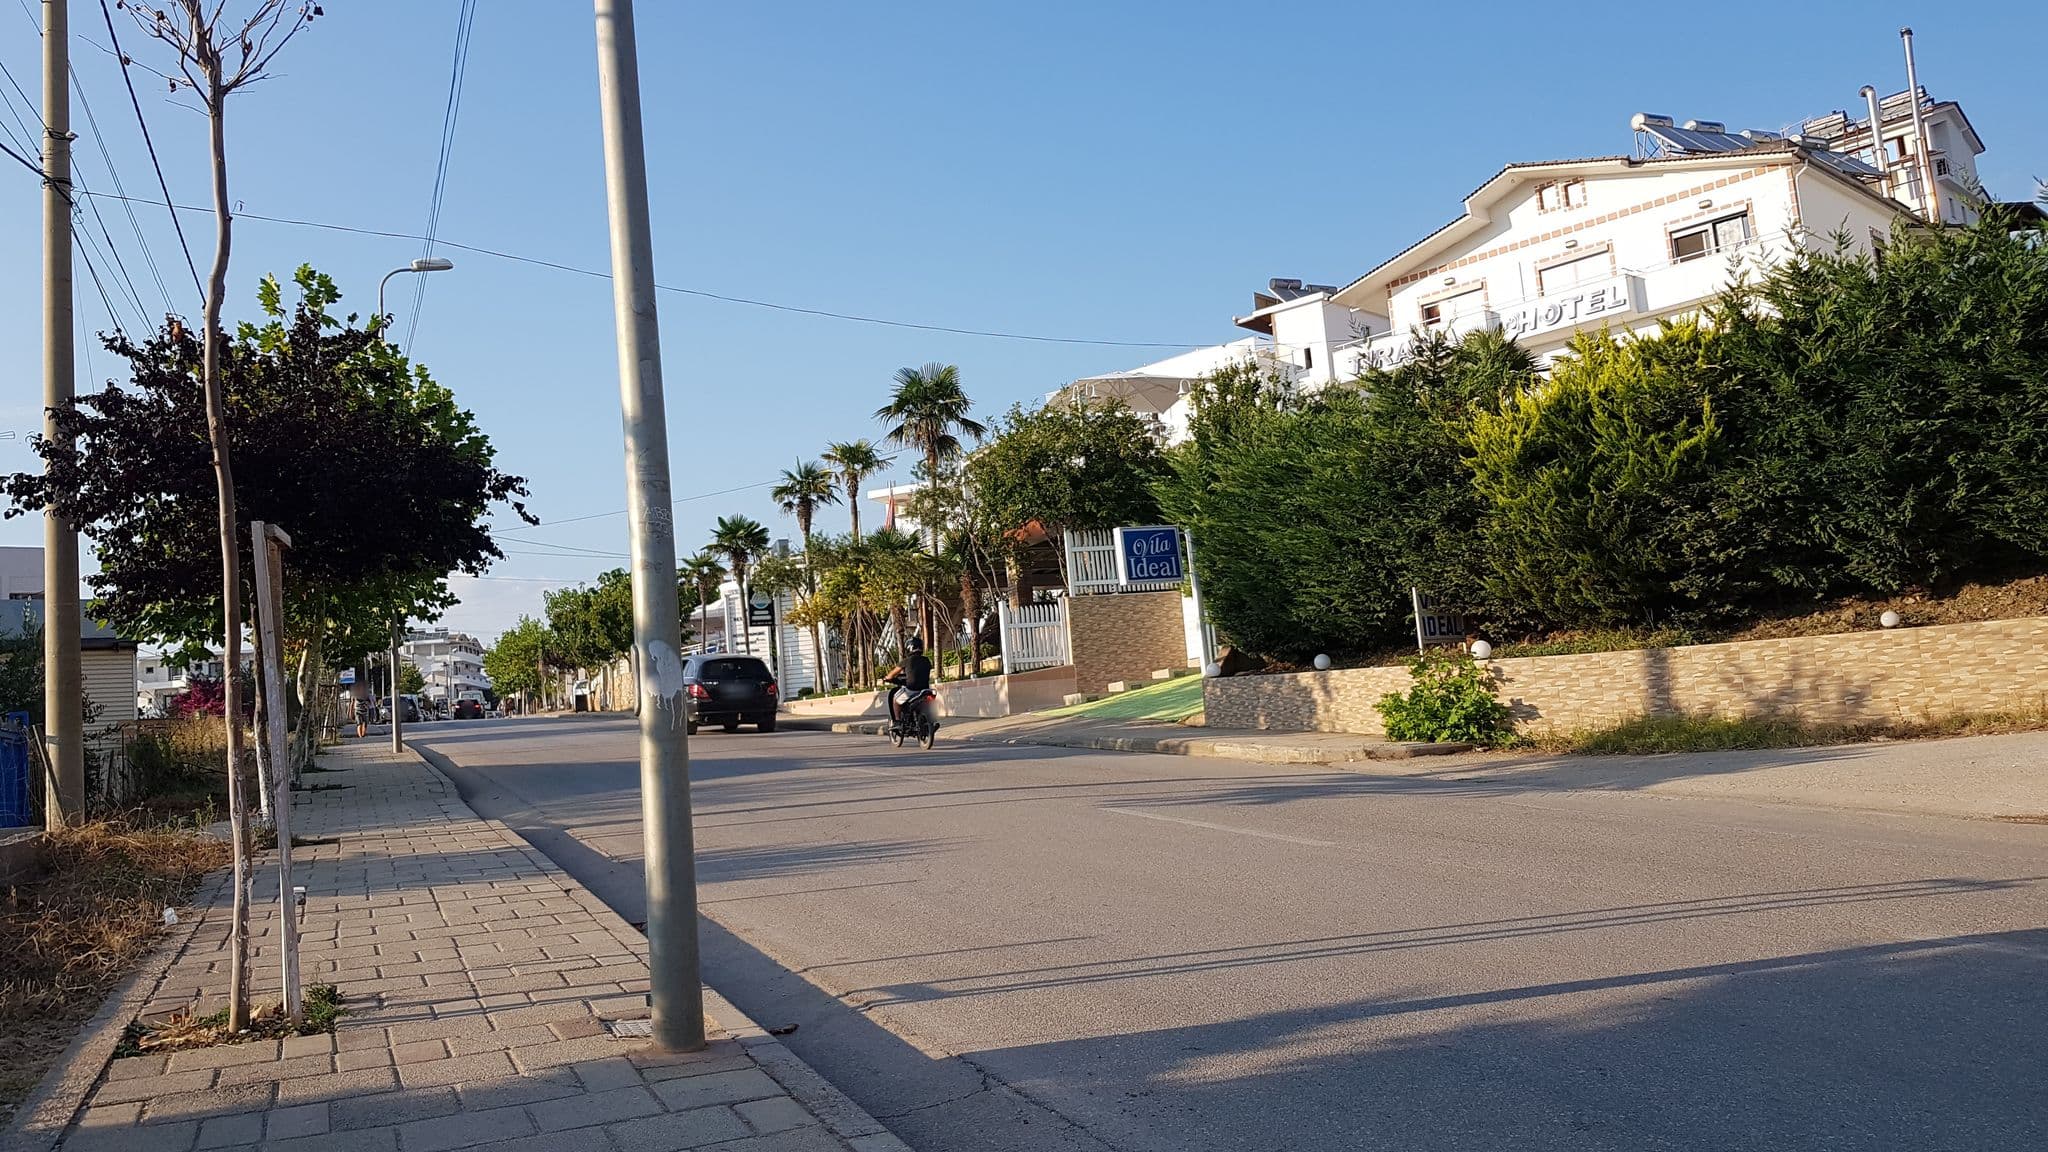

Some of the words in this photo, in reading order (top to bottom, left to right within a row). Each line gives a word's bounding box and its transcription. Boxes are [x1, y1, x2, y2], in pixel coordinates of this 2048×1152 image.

[1519, 285, 1627, 334] HOTEL
[1133, 532, 1171, 558] Vila
[1129, 557, 1179, 579] Ideal
[1422, 615, 1464, 637] IDEAL
